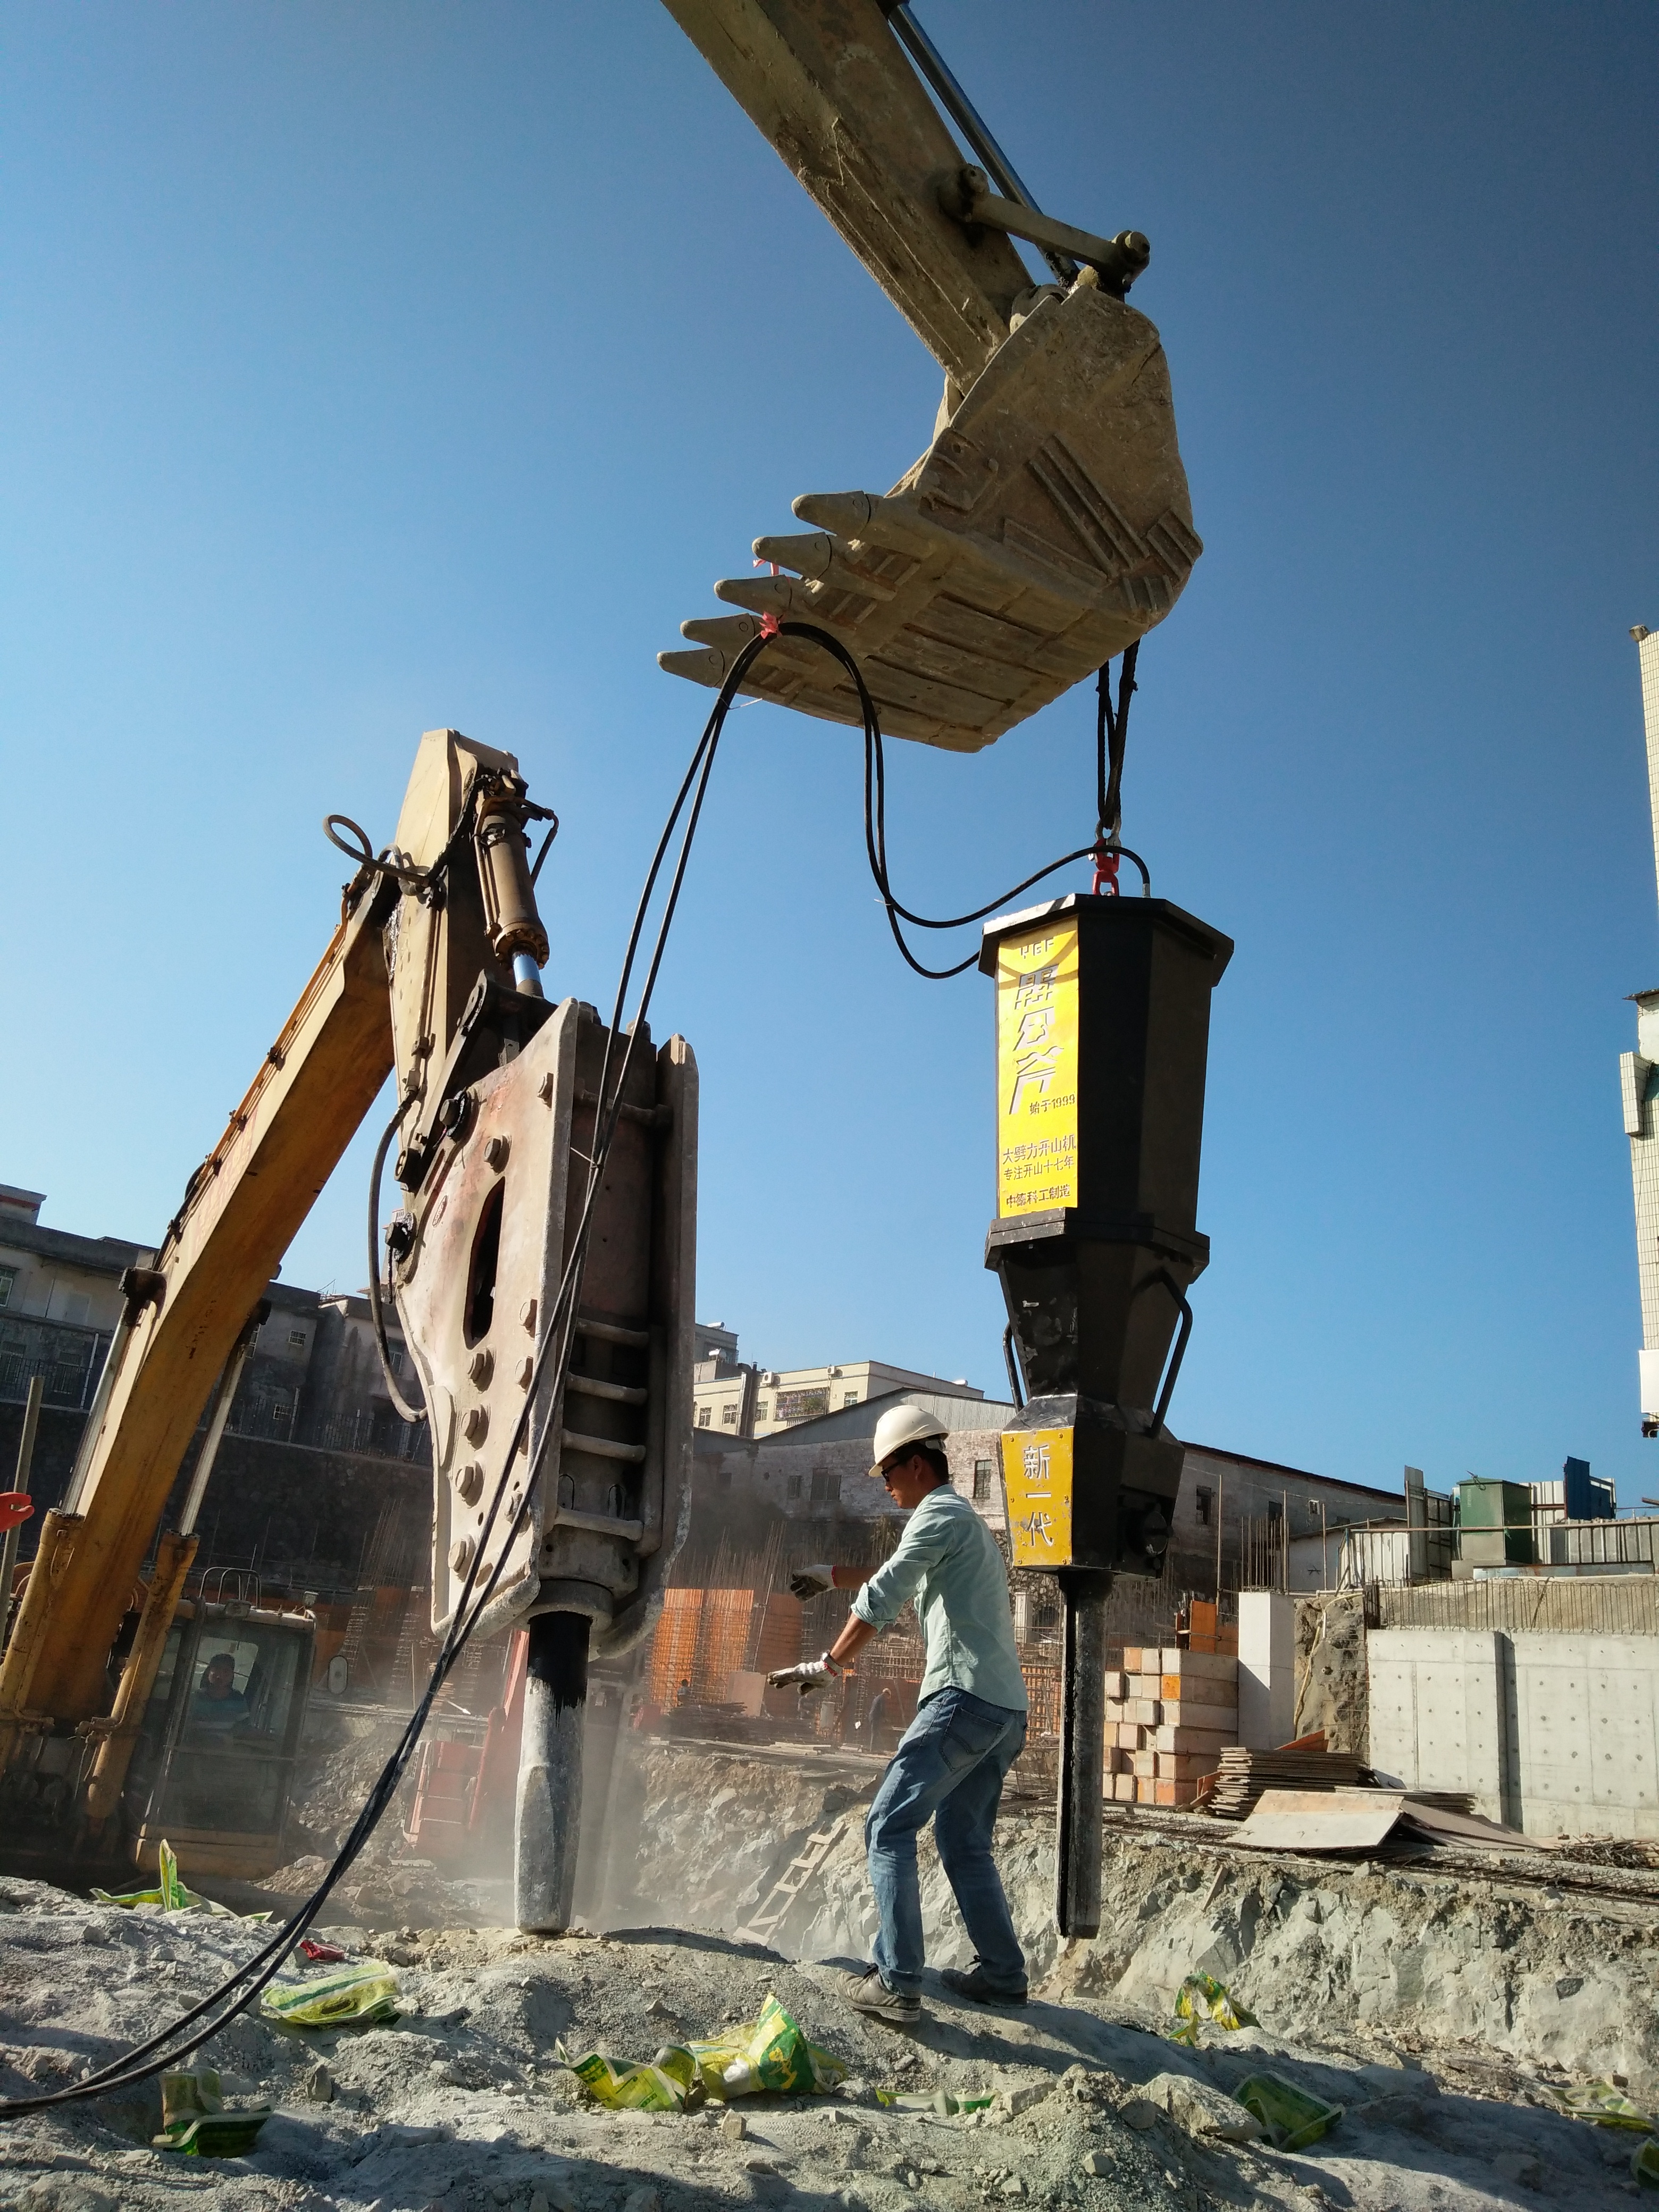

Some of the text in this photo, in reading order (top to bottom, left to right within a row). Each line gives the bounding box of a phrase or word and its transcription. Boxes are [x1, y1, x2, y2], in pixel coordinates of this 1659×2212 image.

[1029, 1093, 1075, 1116] 始于1999
[1002, 1134, 1076, 1164] 大劈力开山机
[1003, 1155, 1075, 1180] 专注开山十七年
[1006, 1183, 1071, 1208] 中德科工制造
[1023, 1444, 1054, 1547] 新一代
